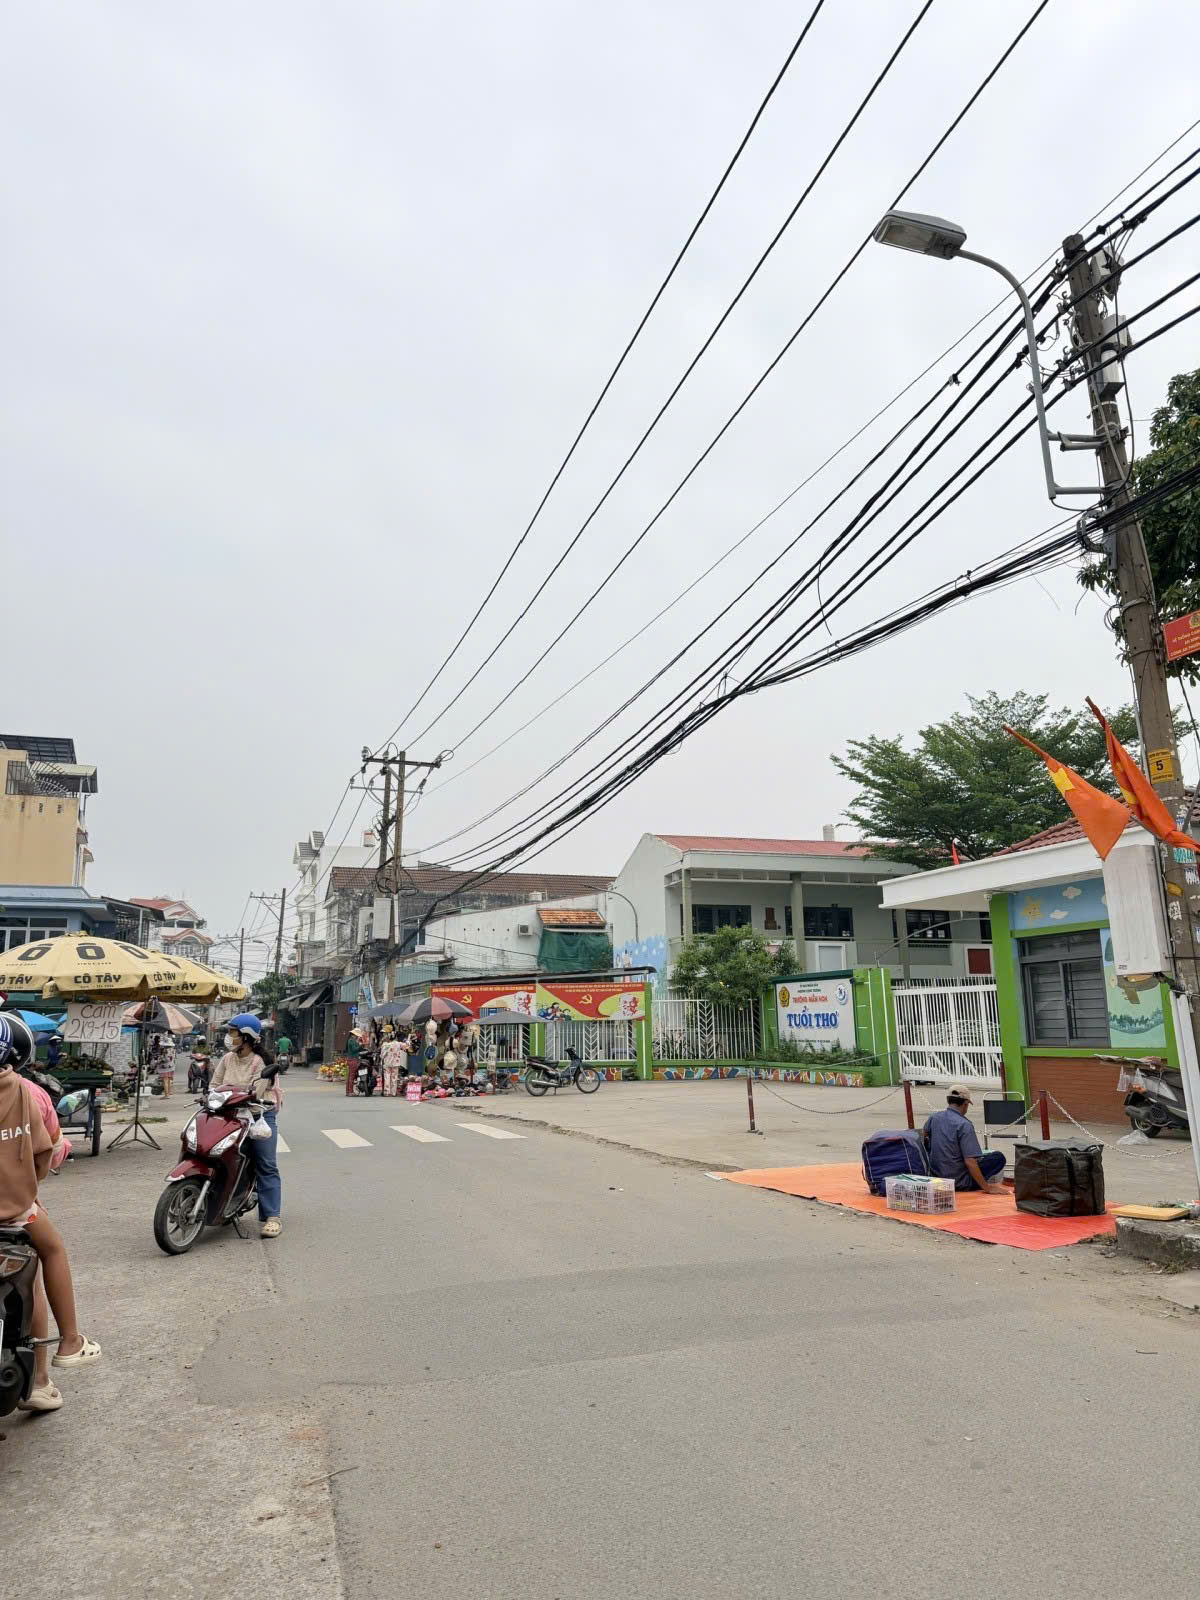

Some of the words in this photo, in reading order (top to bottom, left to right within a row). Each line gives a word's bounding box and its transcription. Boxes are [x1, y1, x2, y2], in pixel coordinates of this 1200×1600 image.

[1155, 759, 1164, 771] 5
[787, 1005, 812, 1027] TUỔI
[814, 1011, 839, 1027] THƠ
